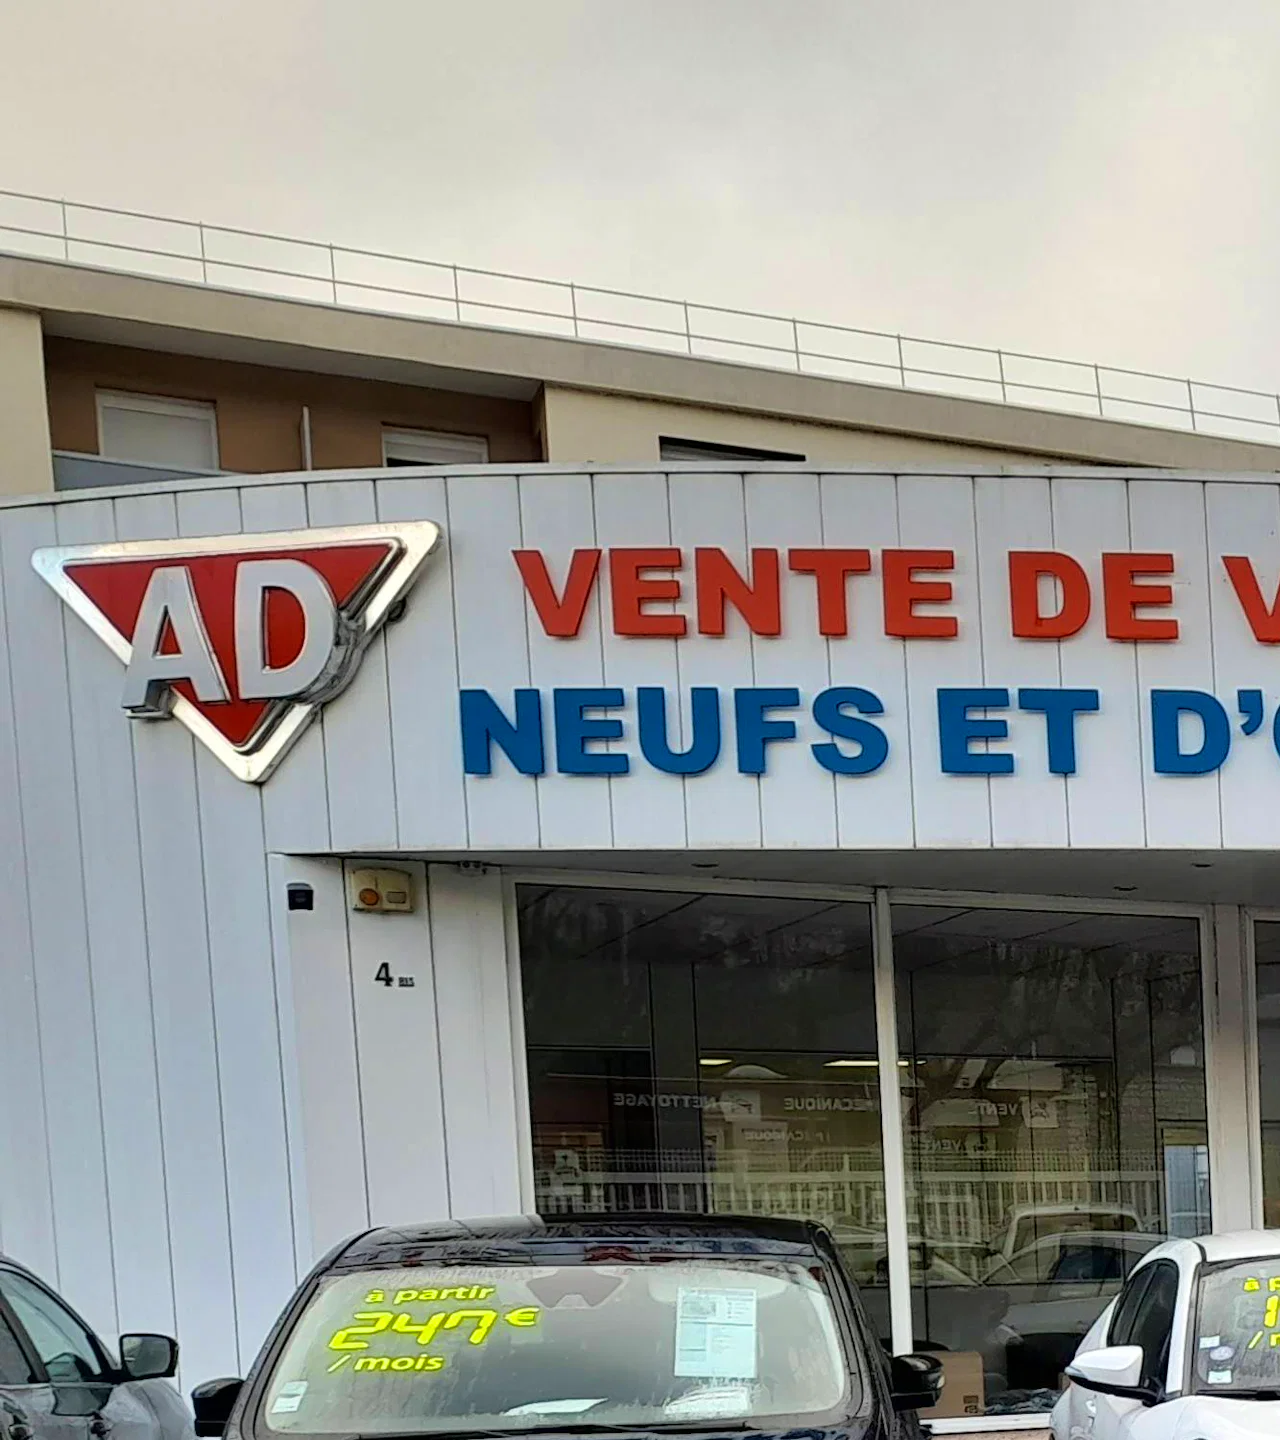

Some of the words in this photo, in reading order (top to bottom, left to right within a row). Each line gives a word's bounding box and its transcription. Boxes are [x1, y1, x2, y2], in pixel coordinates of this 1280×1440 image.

[511, 547, 960, 639] VENTE
[1007, 550, 1180, 642] DE
[122, 558, 337, 710] AD
[458, 686, 892, 776] NEUFS
[936, 687, 1101, 775] ET
[375, 962, 393, 987] 4
[365, 1289, 384, 1303] à
[394, 1285, 495, 1305] partir
[1243, 1277, 1259, 1292] à
[329, 1309, 497, 1350] 247
[504, 1306, 541, 1327] €
[354, 1353, 444, 1371] mois
